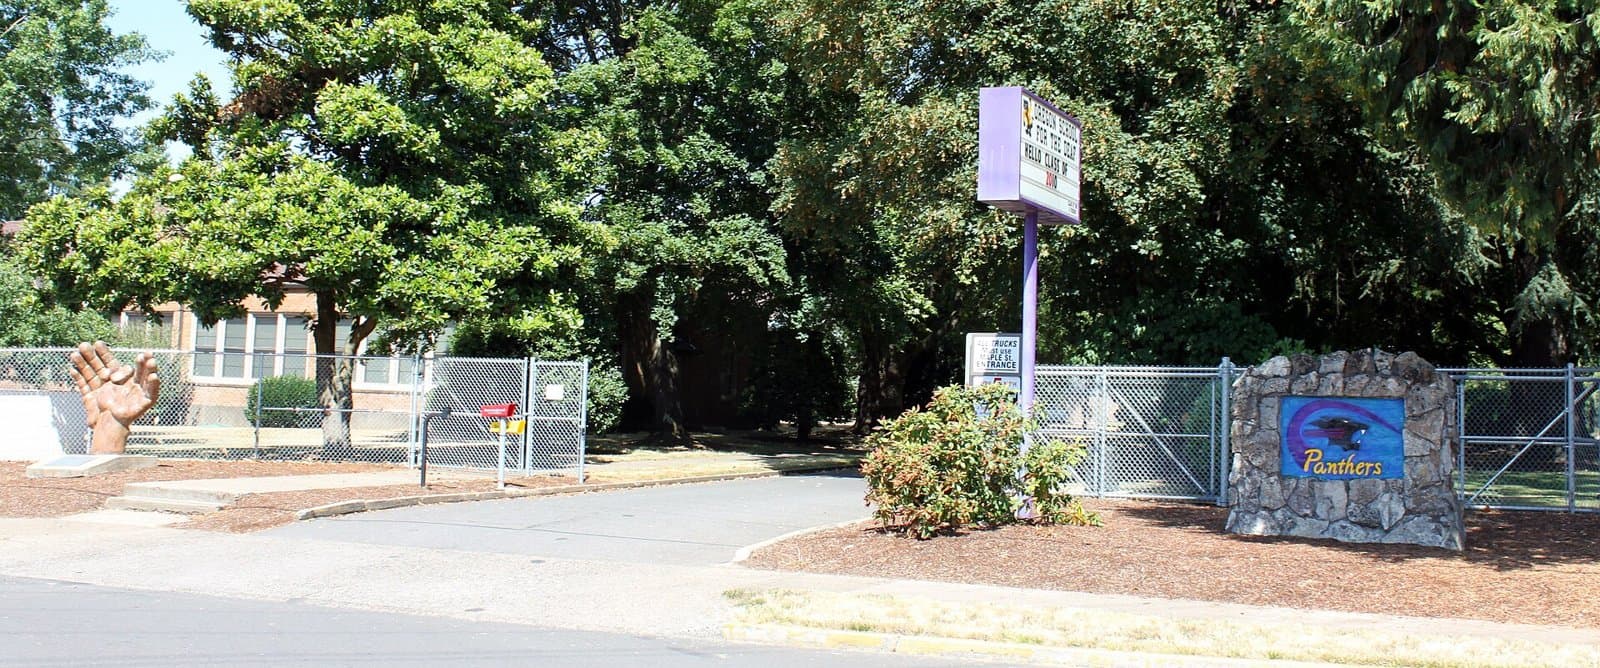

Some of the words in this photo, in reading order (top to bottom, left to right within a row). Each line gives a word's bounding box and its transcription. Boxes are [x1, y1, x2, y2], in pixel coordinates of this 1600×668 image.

[1036, 125, 1047, 146] FOR
[1050, 133, 1061, 153] THE
[1064, 140, 1076, 160] DEAF
[1025, 143, 1041, 163] HELLO
[1045, 153, 1060, 173] CLASS
[1062, 161, 1068, 176] OF
[1303, 448, 1383, 475] Panthers
